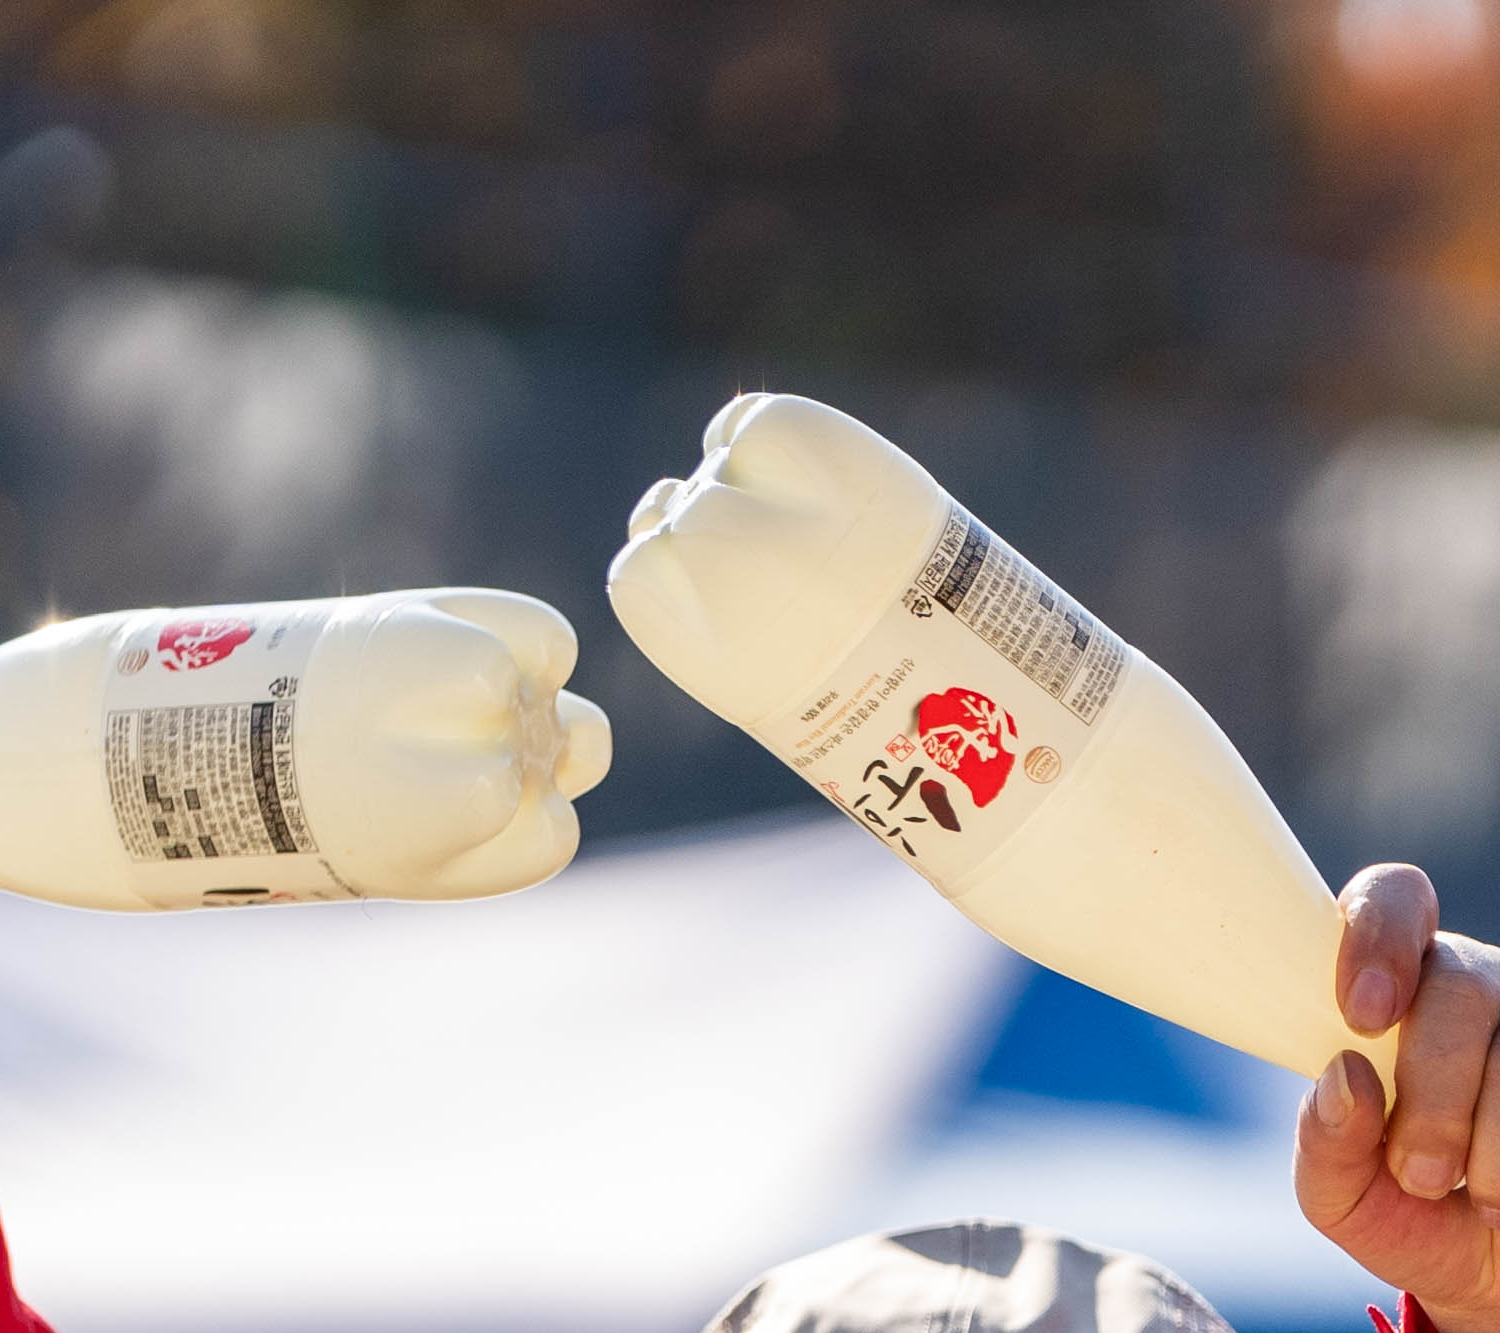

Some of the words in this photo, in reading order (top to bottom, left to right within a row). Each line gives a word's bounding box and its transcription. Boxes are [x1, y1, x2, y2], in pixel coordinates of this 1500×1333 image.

[917, 552, 950, 592] 판매금지
[875, 656, 917, 701] 신선함이
[839, 697, 880, 736] 한결같은
